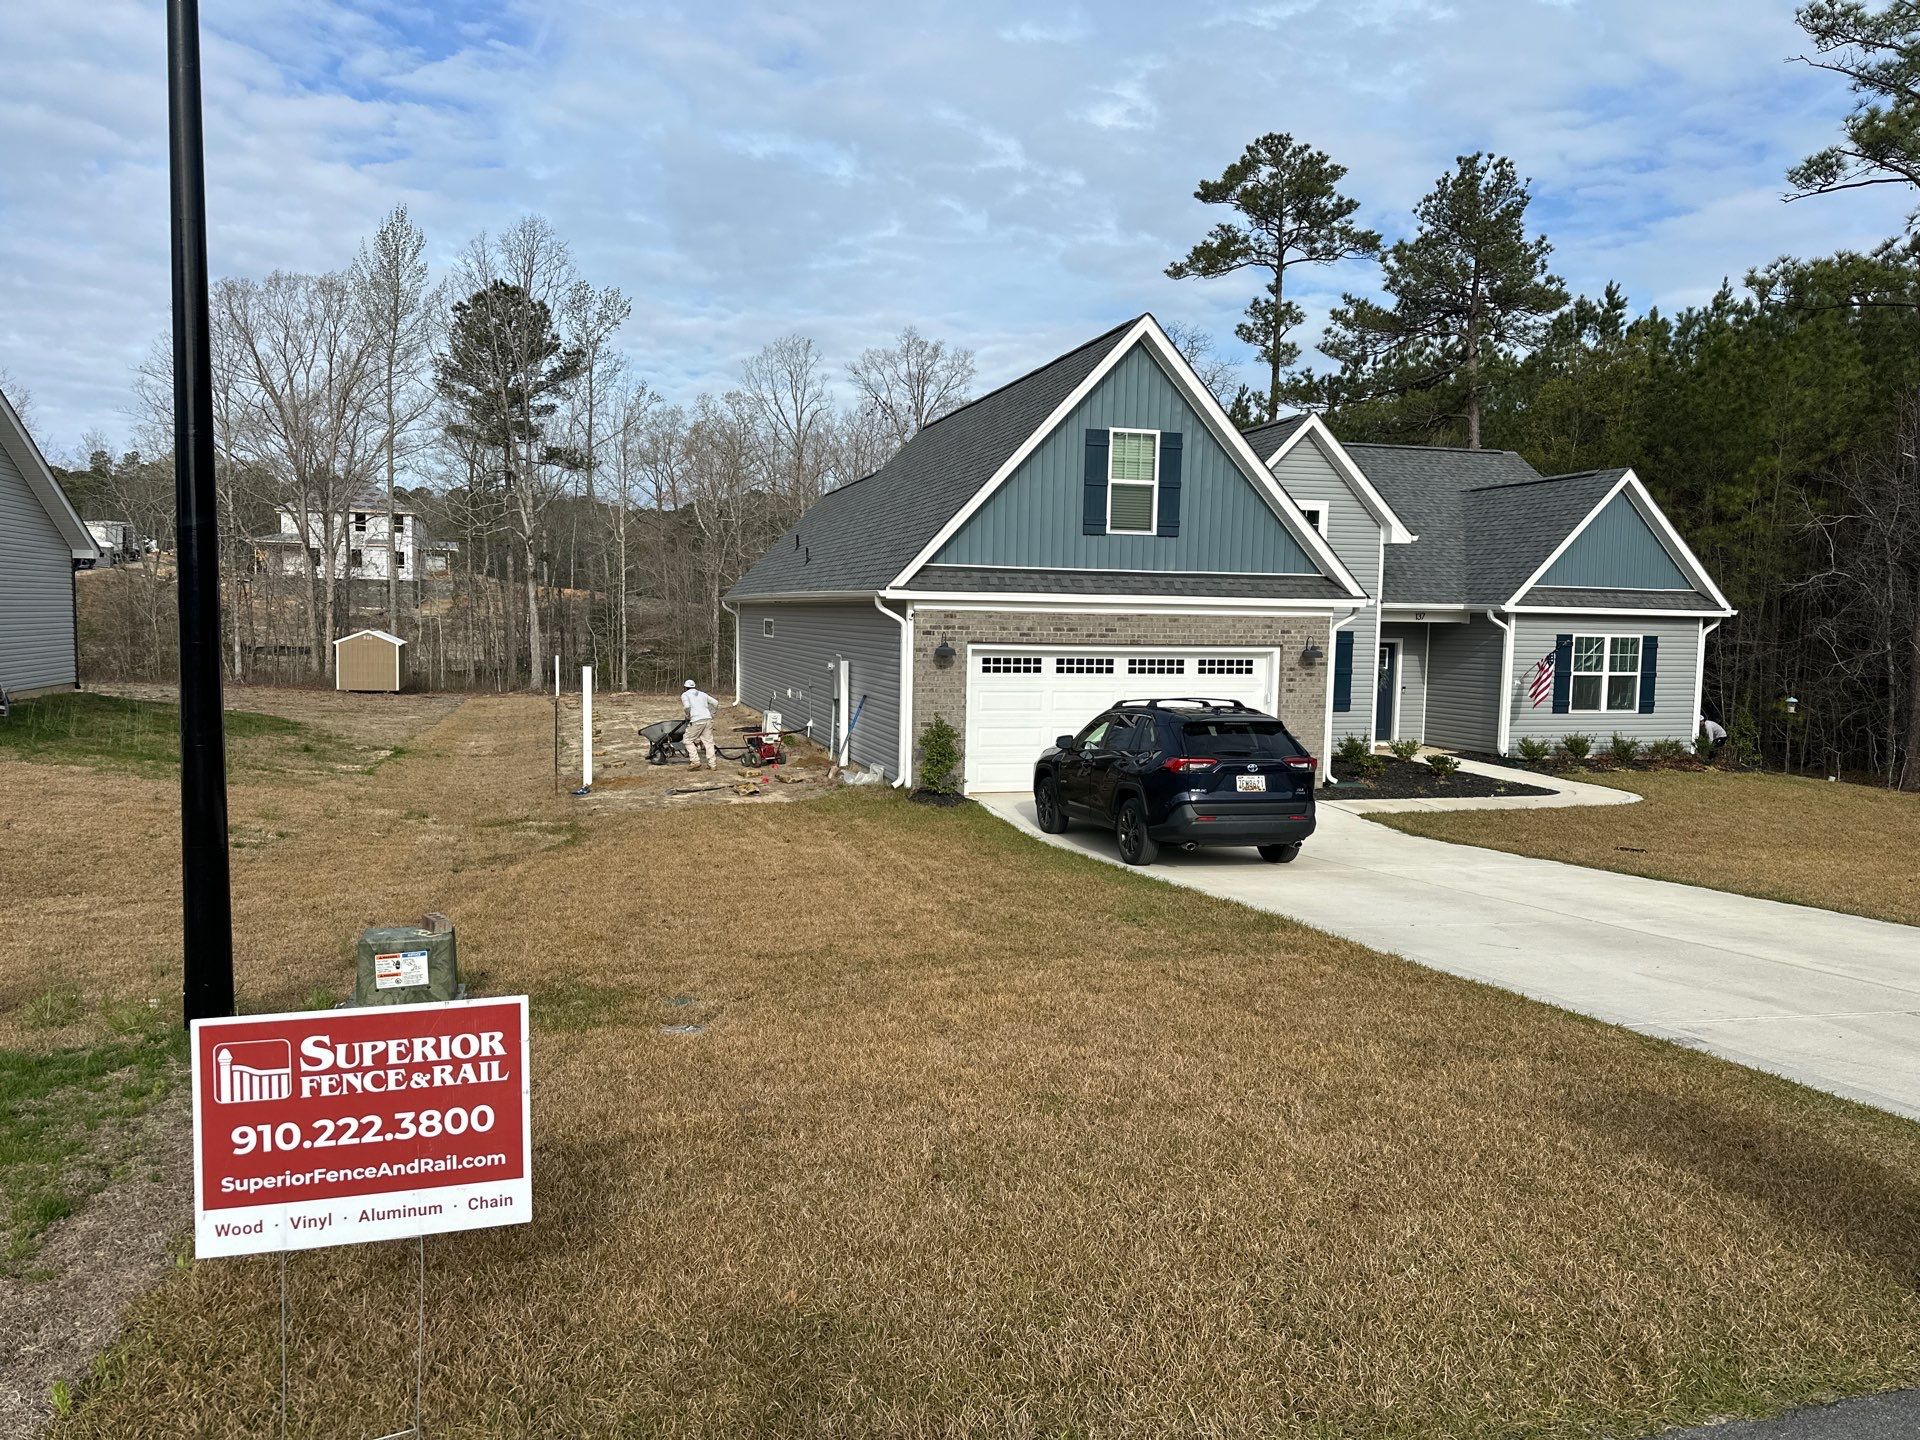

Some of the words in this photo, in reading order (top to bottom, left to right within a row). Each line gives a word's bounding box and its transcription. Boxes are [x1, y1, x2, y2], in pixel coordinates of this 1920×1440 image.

[1415, 612, 1426, 620] 137
[299, 1032, 508, 1072] SUPERIOR
[230, 1104, 495, 1156] 910.222.3800
[220, 1153, 506, 1193] SuperiorFenceAndRail.com
[214, 1220, 264, 1238] Wood
[289, 1212, 333, 1231] Vinyl
[357, 1202, 443, 1223] Aluminum
[467, 1193, 514, 1211] Chain
